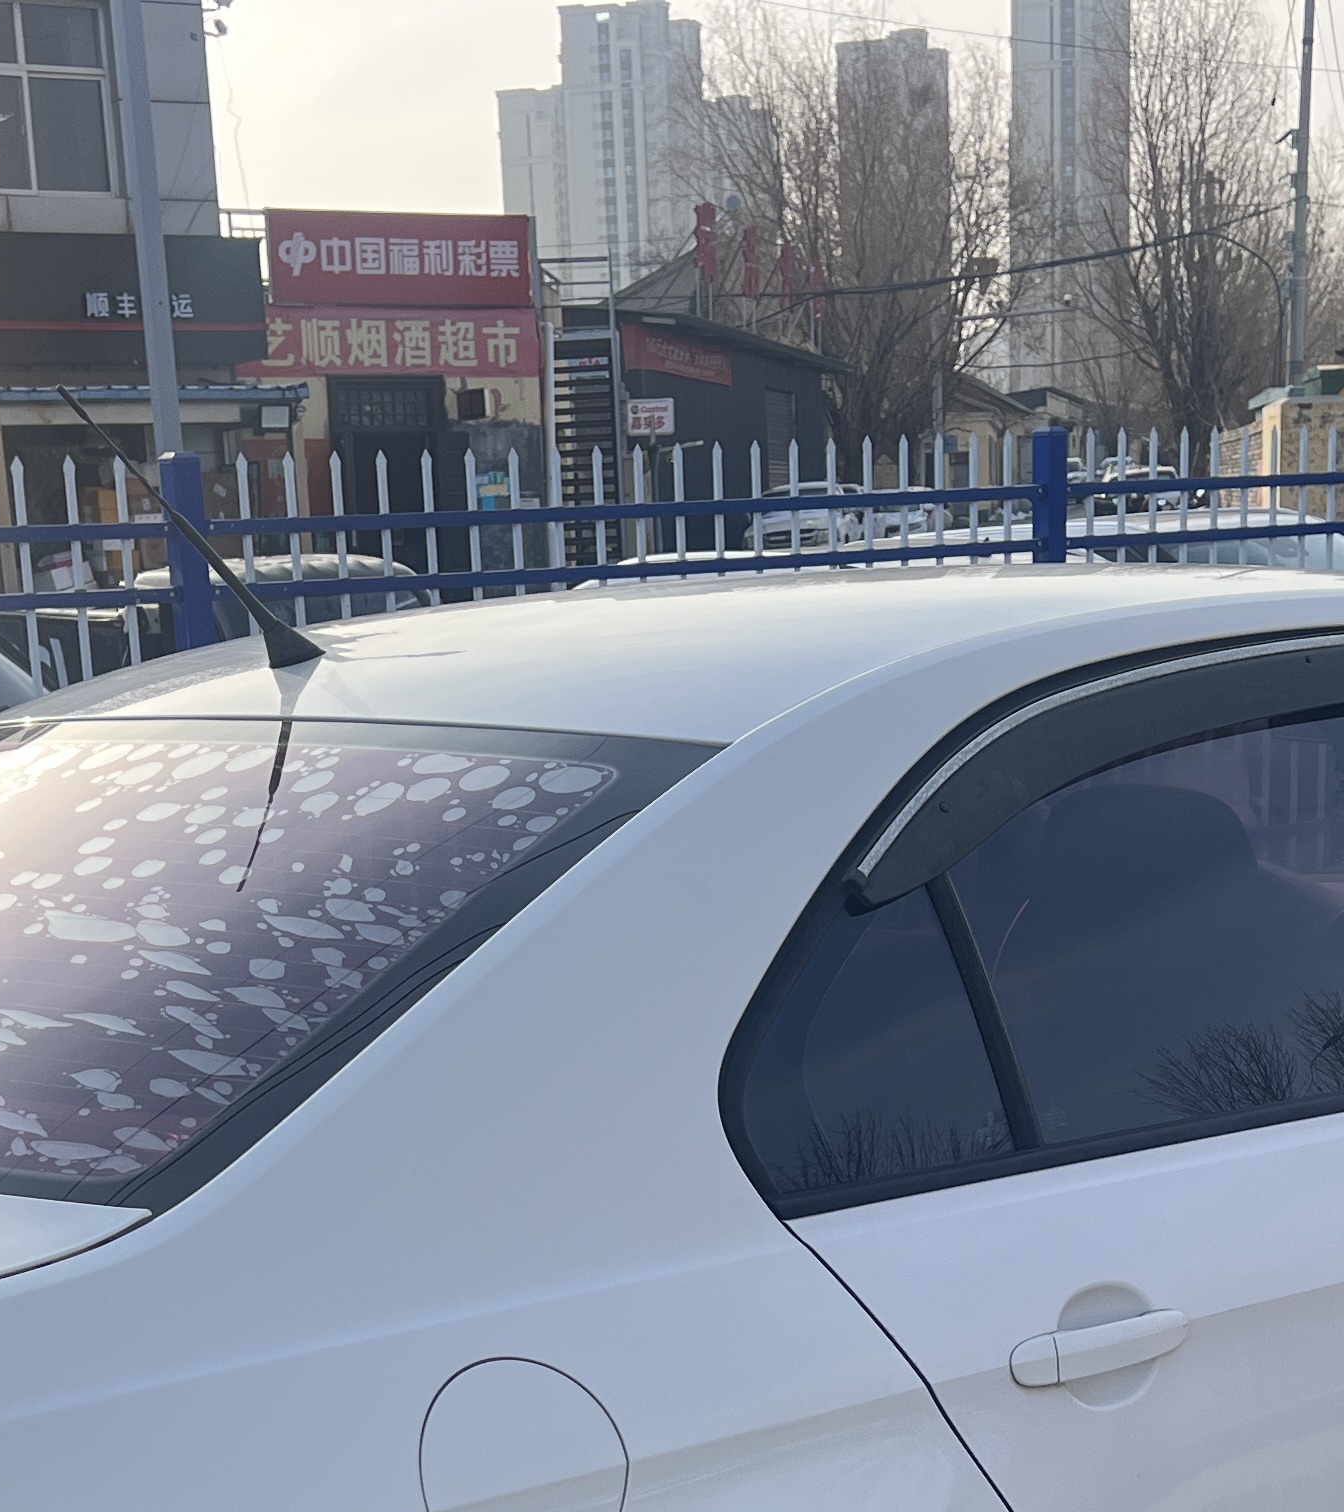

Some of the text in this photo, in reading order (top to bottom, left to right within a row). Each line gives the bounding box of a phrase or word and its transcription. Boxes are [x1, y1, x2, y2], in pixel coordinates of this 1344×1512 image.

[319, 237, 520, 278] 中国福利彩票
[85, 292, 194, 318] 顺丰运
[262, 317, 521, 368] 艺顺烟酒超市
